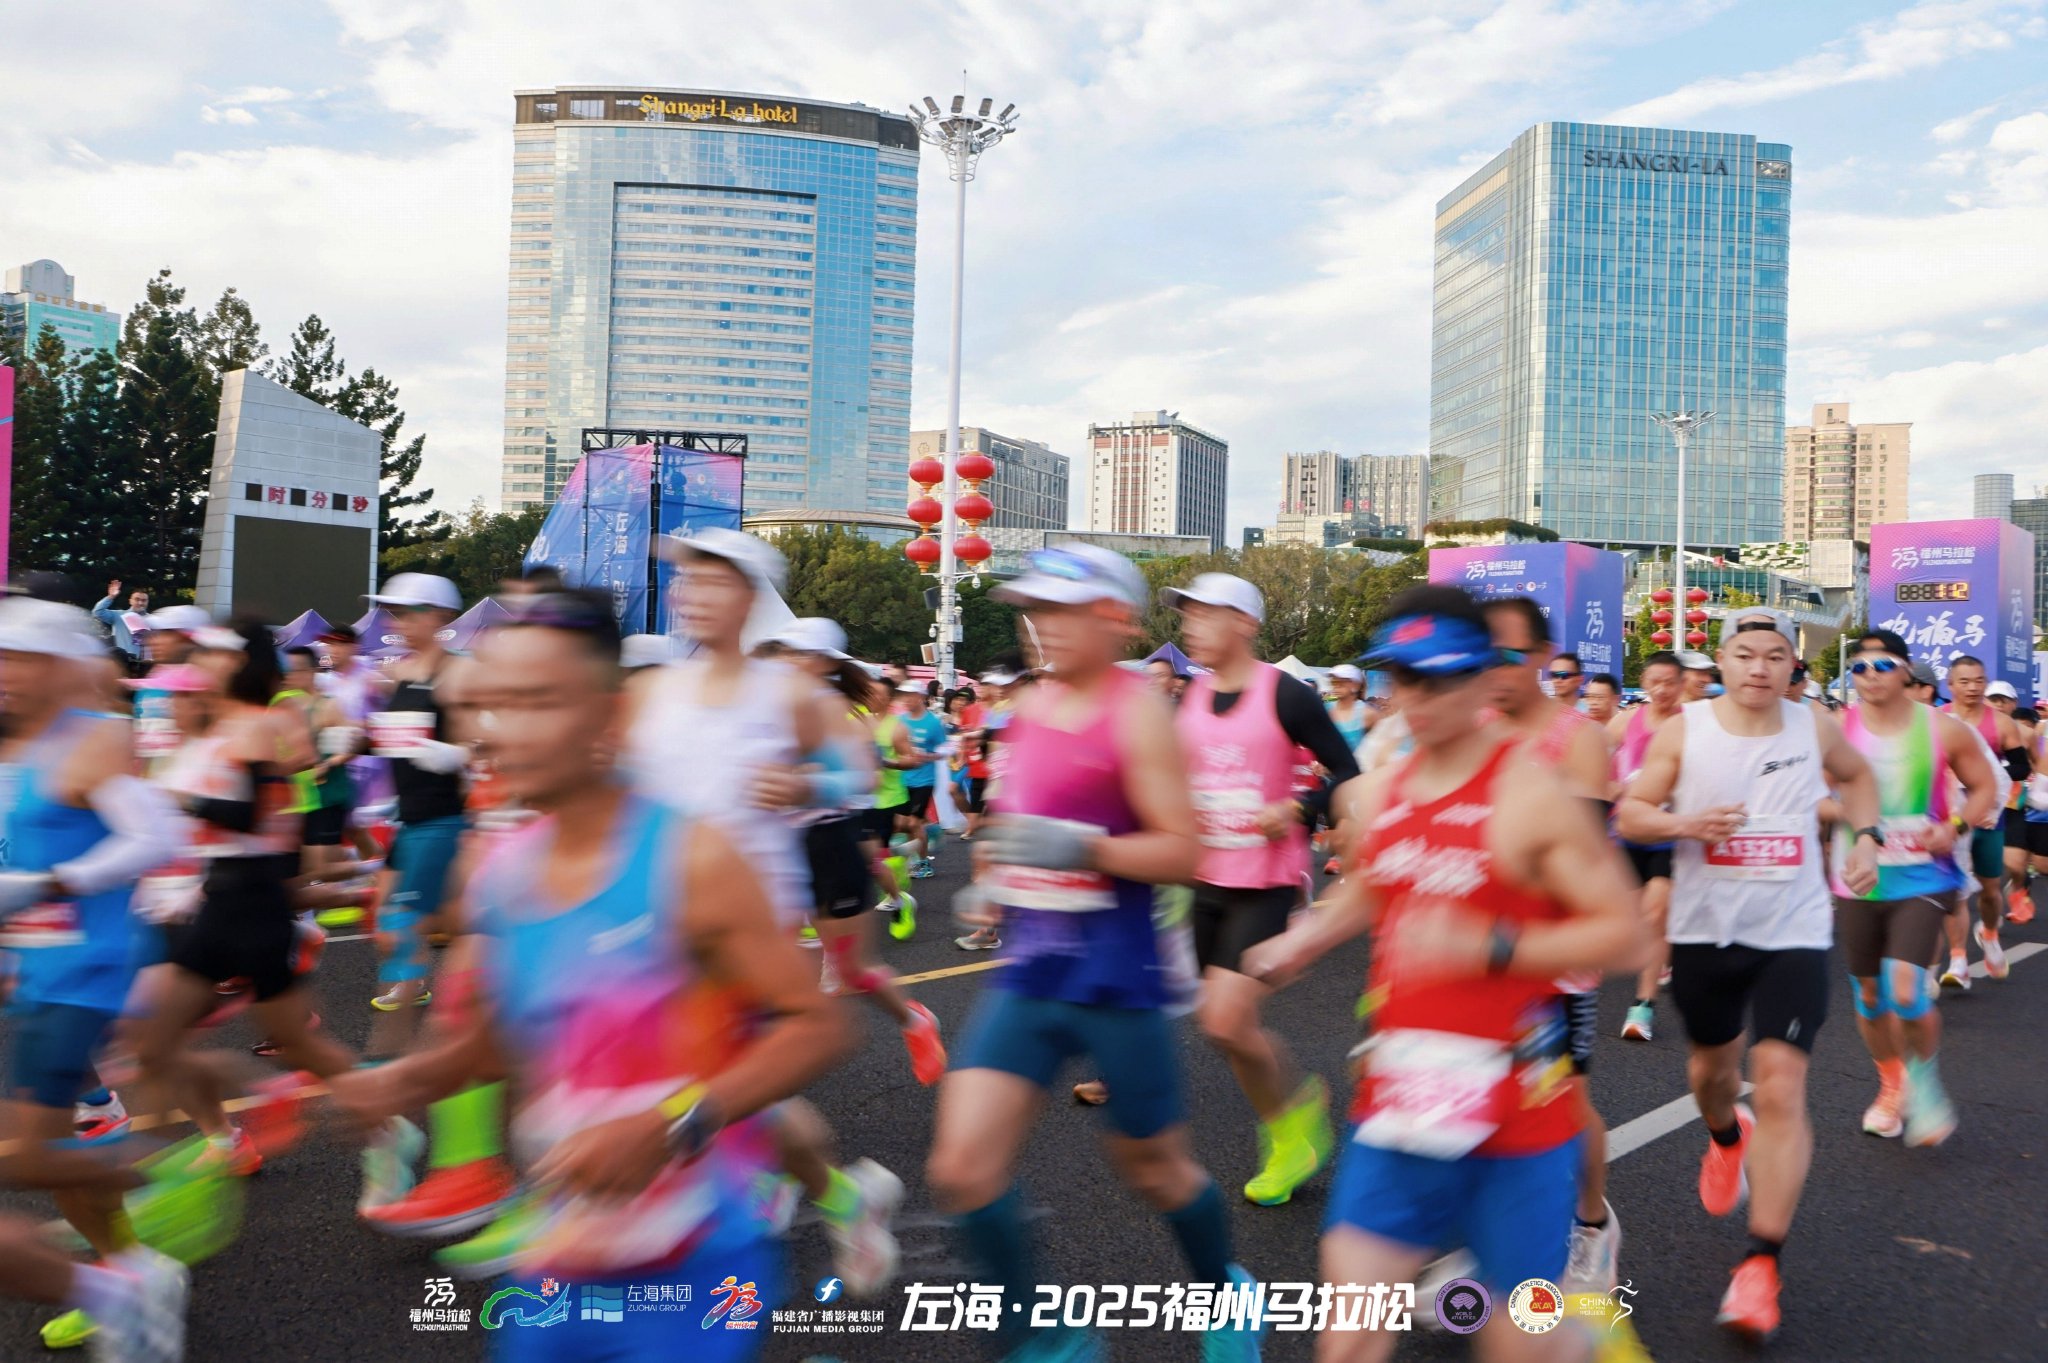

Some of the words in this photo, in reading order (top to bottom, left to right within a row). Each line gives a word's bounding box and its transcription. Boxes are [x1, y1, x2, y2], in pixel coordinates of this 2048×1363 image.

[639, 94, 747, 121] Shangri-La
[753, 103, 798, 123] hotel
[1584, 149, 1729, 176] SHANGRI-LA
[268, 486, 286, 505] 时
[312, 491, 328, 508] 分
